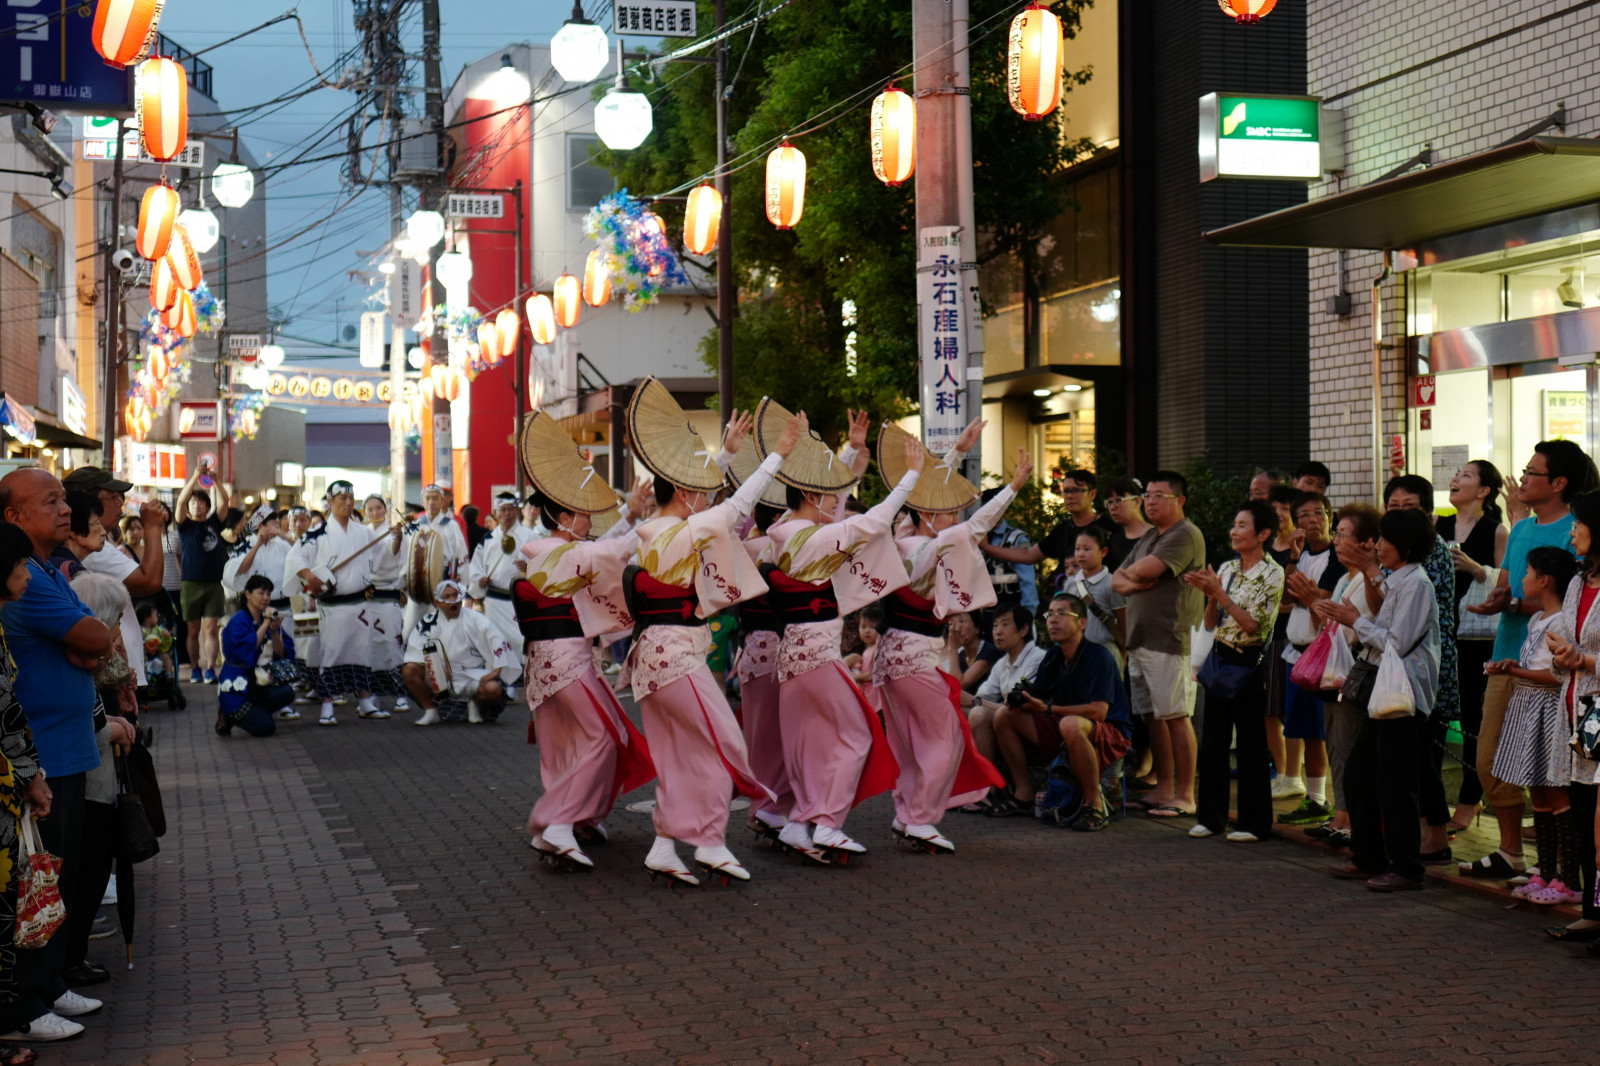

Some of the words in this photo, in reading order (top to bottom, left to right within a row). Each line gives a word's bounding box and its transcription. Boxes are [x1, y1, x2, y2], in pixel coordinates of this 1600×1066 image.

[33, 83, 93, 99] 御嶽山店
[1246, 126, 1271, 137] SMBC
[932, 254, 961, 416] 永石産婦人科
[1417, 376, 1435, 386] AED
